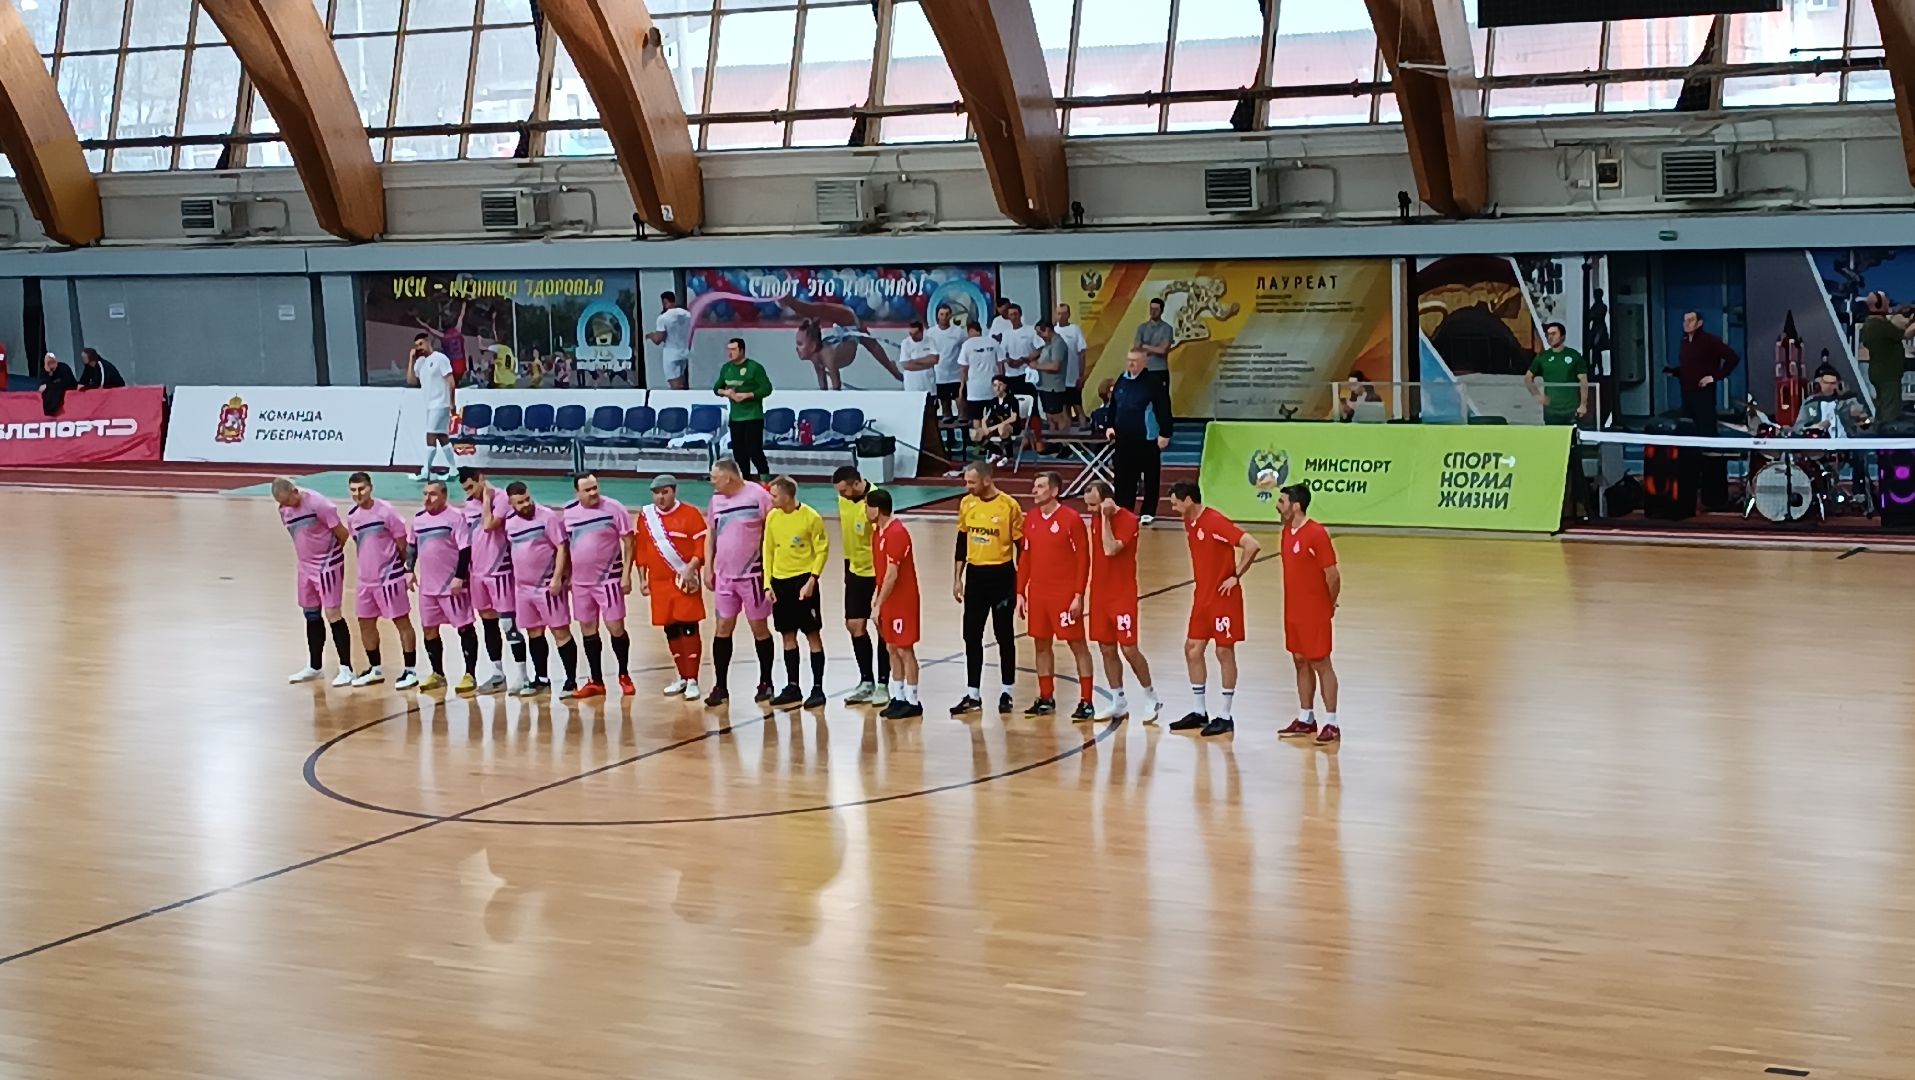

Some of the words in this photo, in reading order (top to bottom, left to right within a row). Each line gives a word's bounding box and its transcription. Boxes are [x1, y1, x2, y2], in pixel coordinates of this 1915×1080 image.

[393, 276, 427, 298] УСК
[524, 278, 604, 299] ЗДОРОВЬЯ
[808, 278, 836, 297] ЭТО
[1256, 275, 1338, 290] ЛАУРЕАТ
[259, 410, 322, 422] КОМАНДА
[255, 428, 343, 441] ГУБЕРНАТОРА
[1304, 458, 1392, 473] МИНСПОРТ
[1443, 452, 1503, 470] СПОРТ
[1303, 478, 1367, 494] РОССИИ
[1440, 472, 1513, 490] НОРМА
[1438, 491, 1509, 510] ЖИЗНИ
